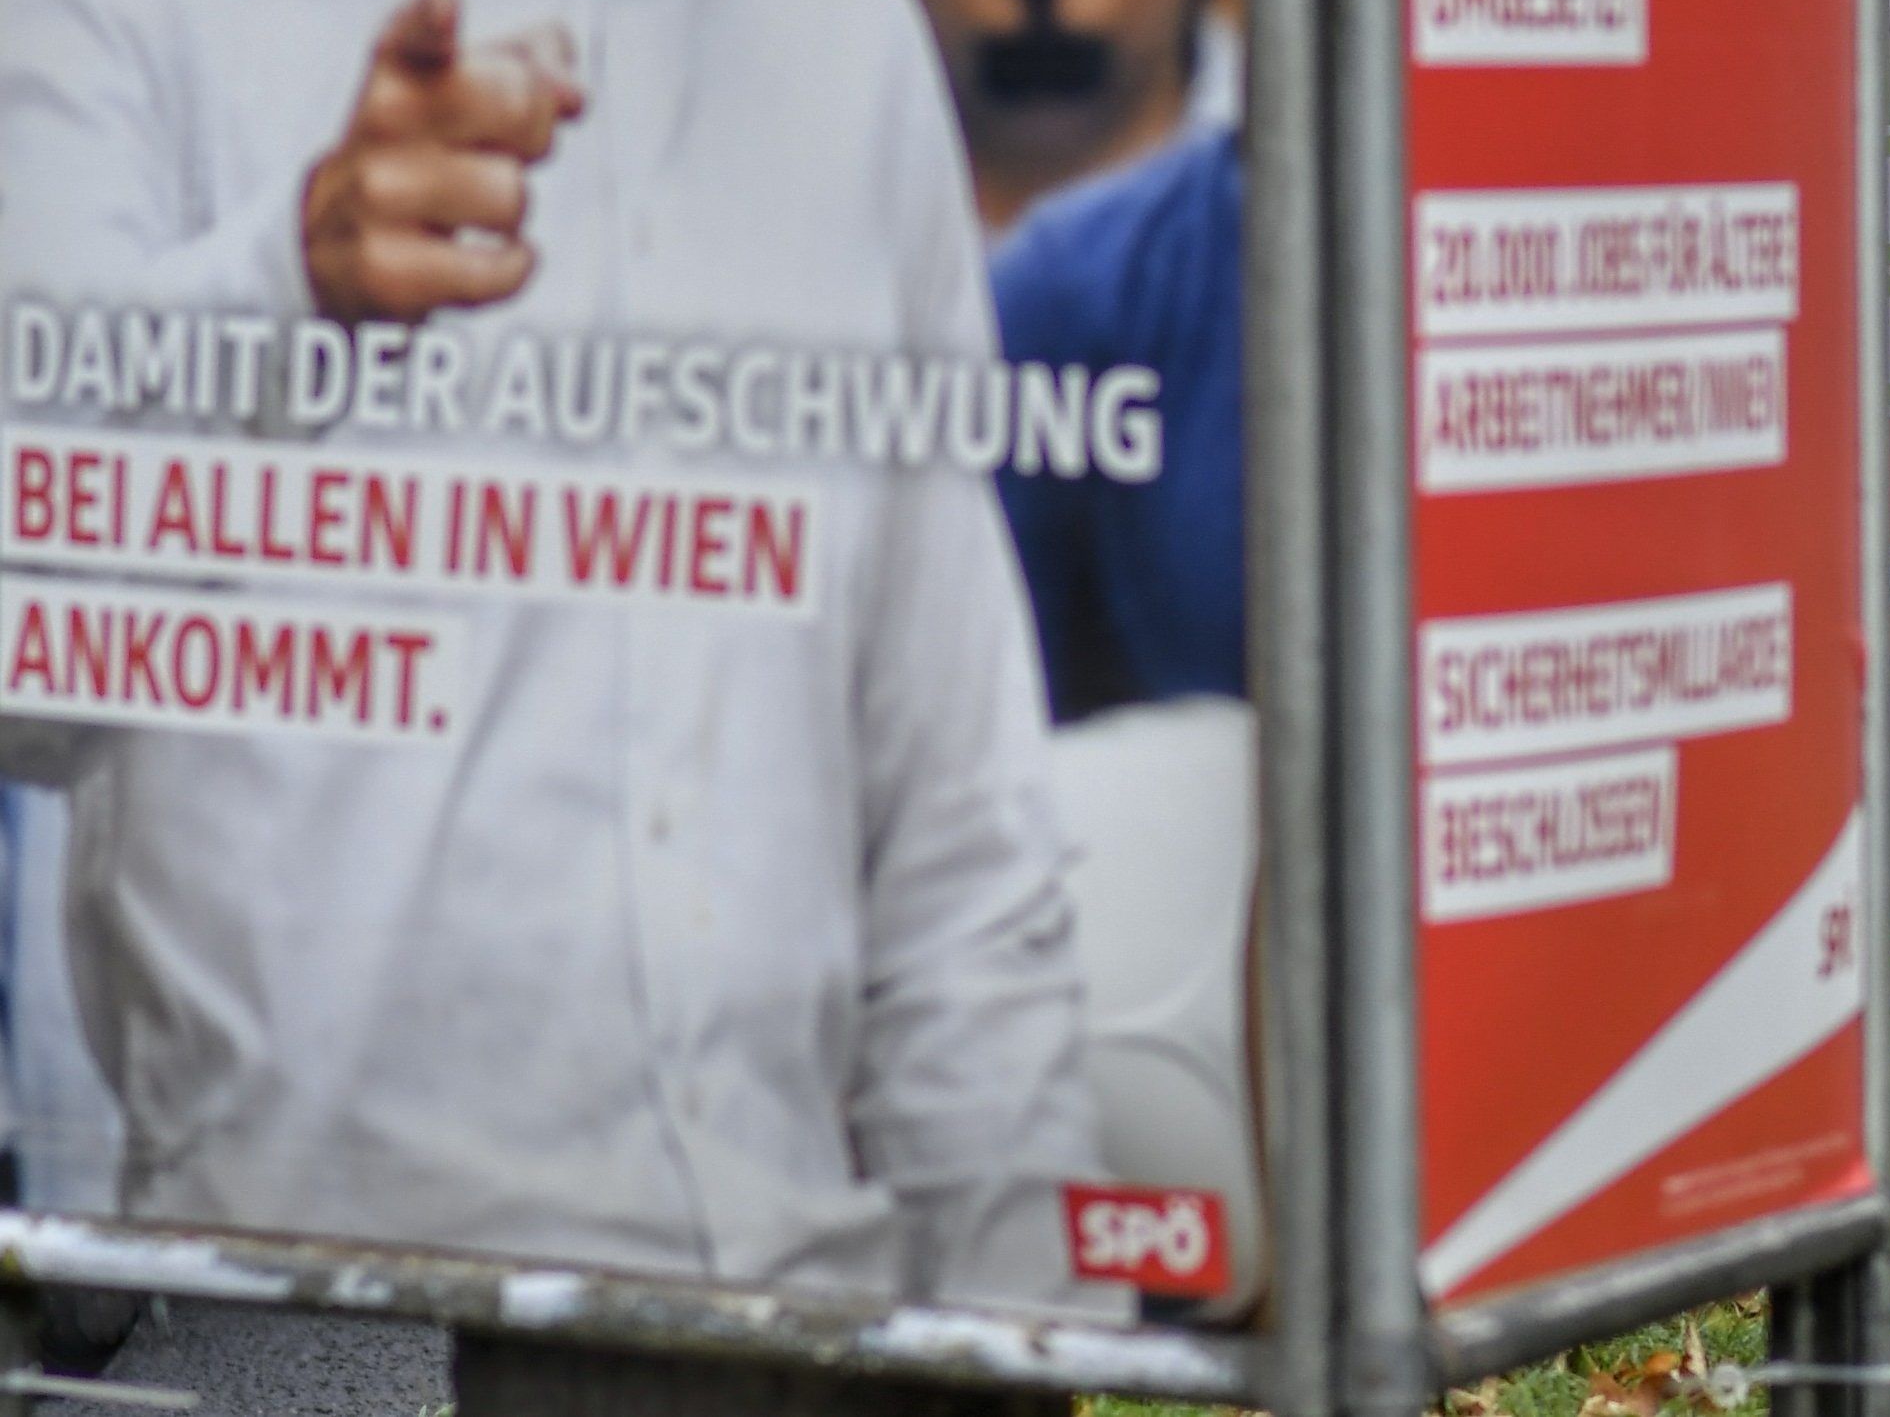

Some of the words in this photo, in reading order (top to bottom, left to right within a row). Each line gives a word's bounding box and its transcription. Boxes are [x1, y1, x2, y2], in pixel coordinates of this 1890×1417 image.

[9, 303, 272, 419] DAMIT
[290, 318, 465, 434] DER
[485, 330, 1163, 482] AUFSCHWUNG
[14, 447, 128, 551] BEI
[148, 459, 419, 571] ALLEN
[444, 479, 536, 577] IN
[563, 488, 807, 603] WIEN
[8, 601, 449, 734] ANKOMMT.
[1080, 1192, 1210, 1278] SPÖ
